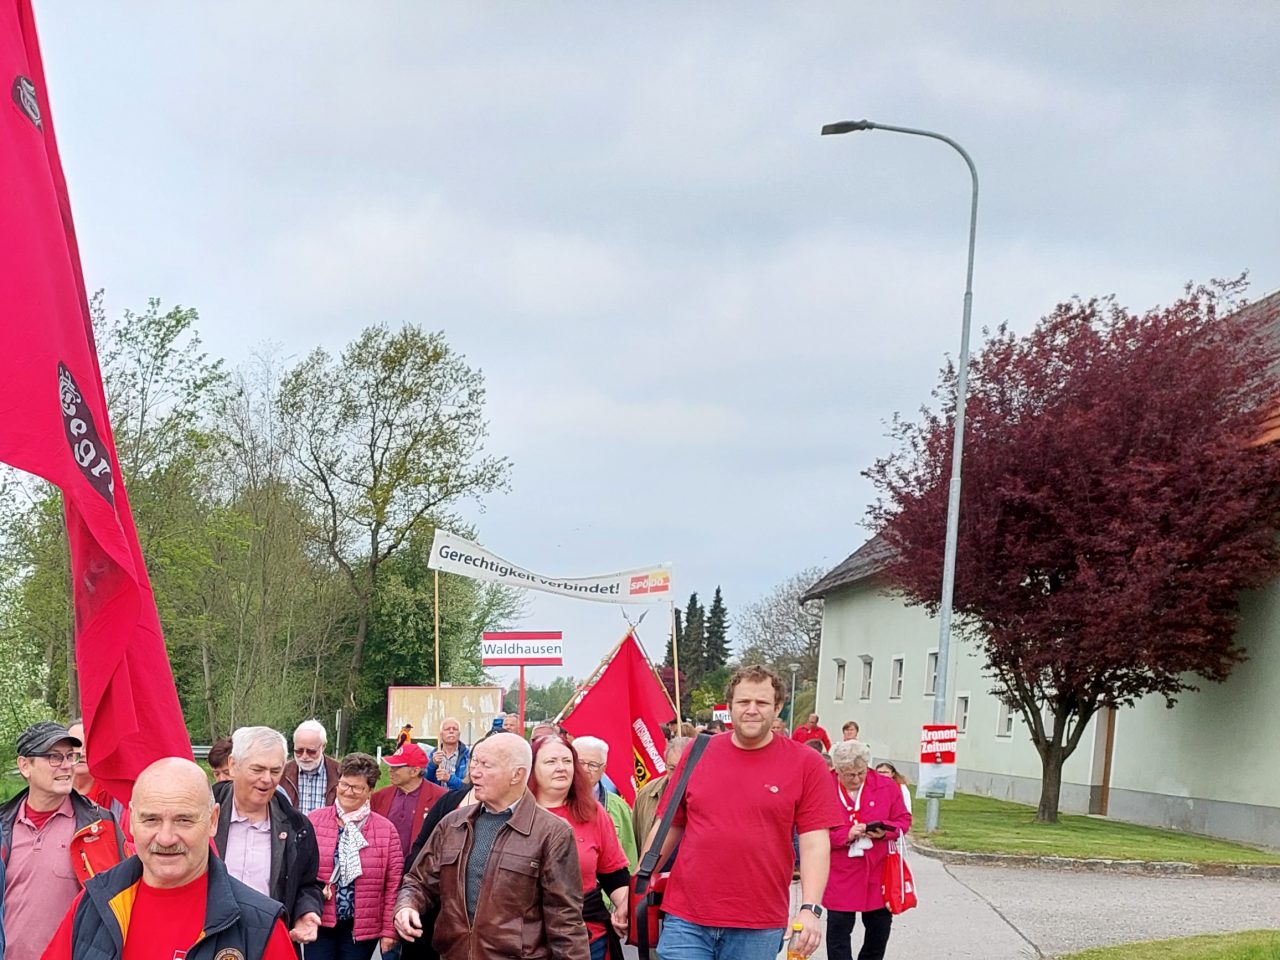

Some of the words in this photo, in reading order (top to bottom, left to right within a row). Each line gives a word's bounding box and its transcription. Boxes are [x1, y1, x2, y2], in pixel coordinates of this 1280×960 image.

[439, 545, 536, 583] Gerechtigkeit
[540, 578, 620, 594] verbindet!
[483, 643, 562, 655] Waldhausen
[921, 729, 957, 741] Kronen
[921, 741, 957, 754] Zeitung
